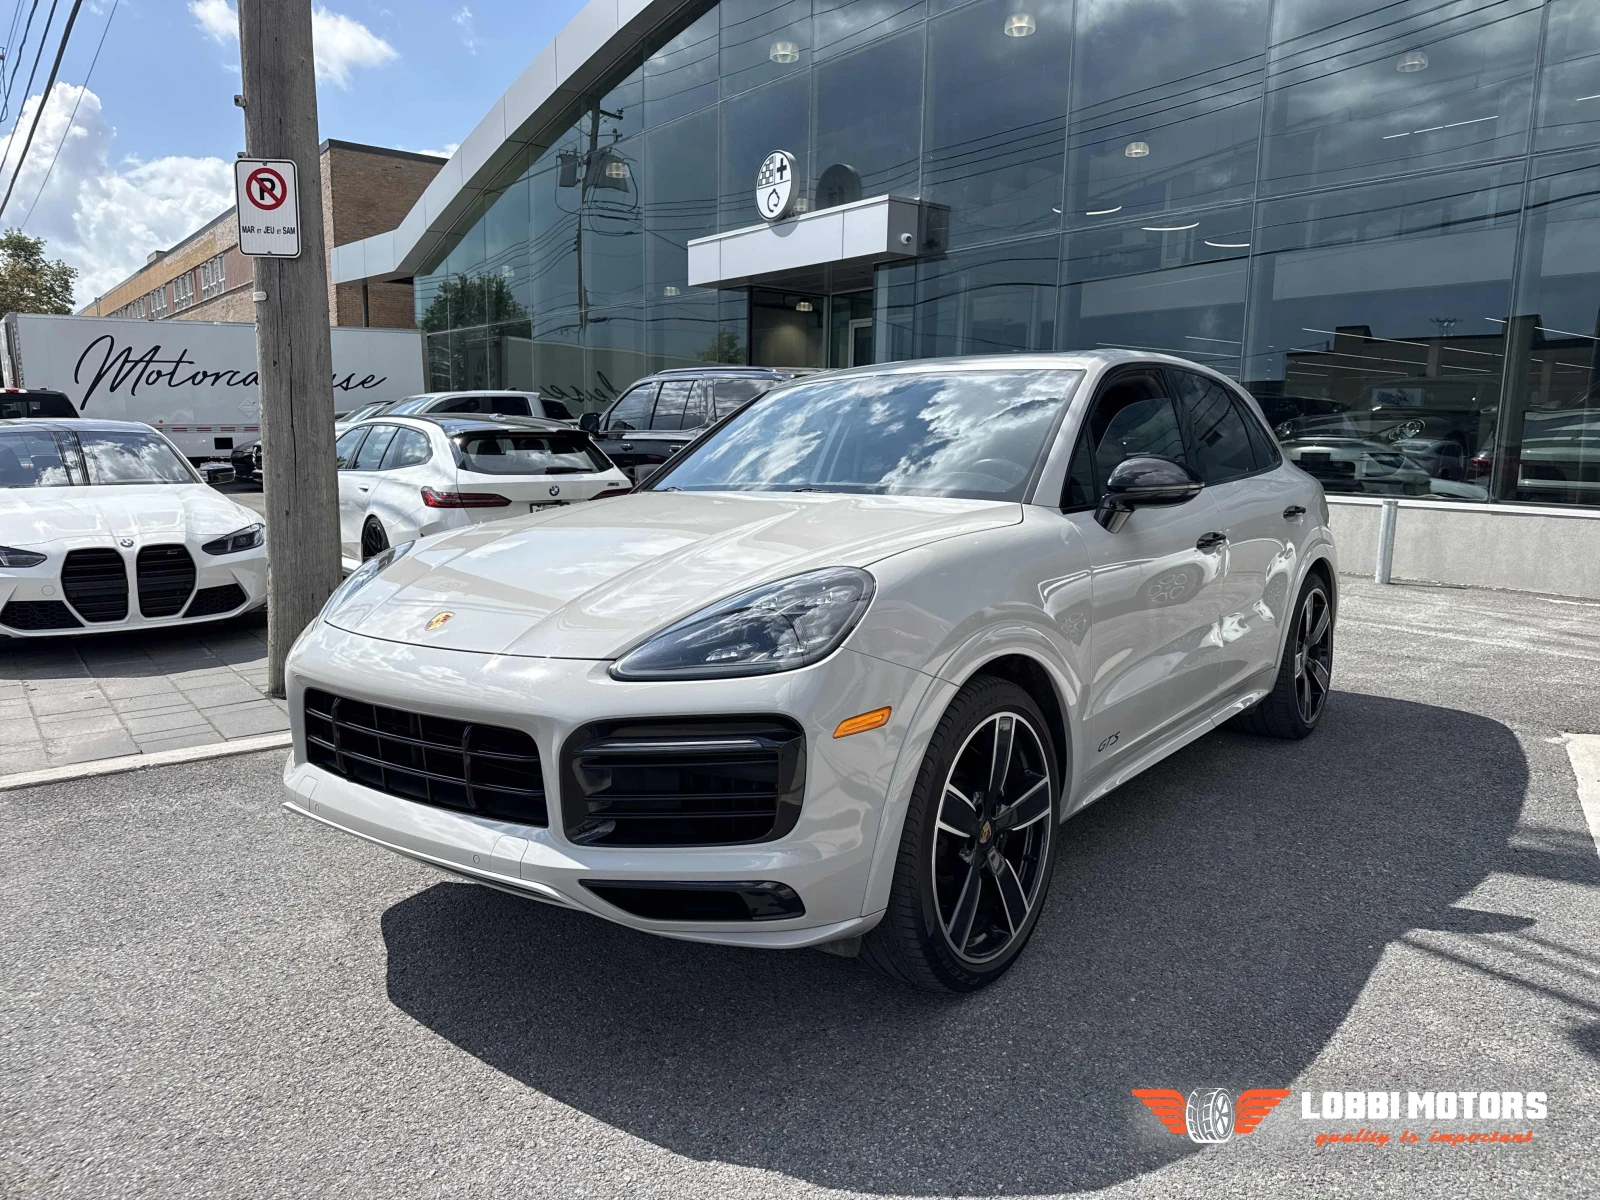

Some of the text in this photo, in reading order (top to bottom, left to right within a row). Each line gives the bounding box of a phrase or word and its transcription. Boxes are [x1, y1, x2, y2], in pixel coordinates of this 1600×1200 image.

[241, 225, 255, 234] MAR
[263, 225, 275, 235] JEU
[282, 226, 296, 235] SAM
[1098, 731, 1121, 753] GTS
